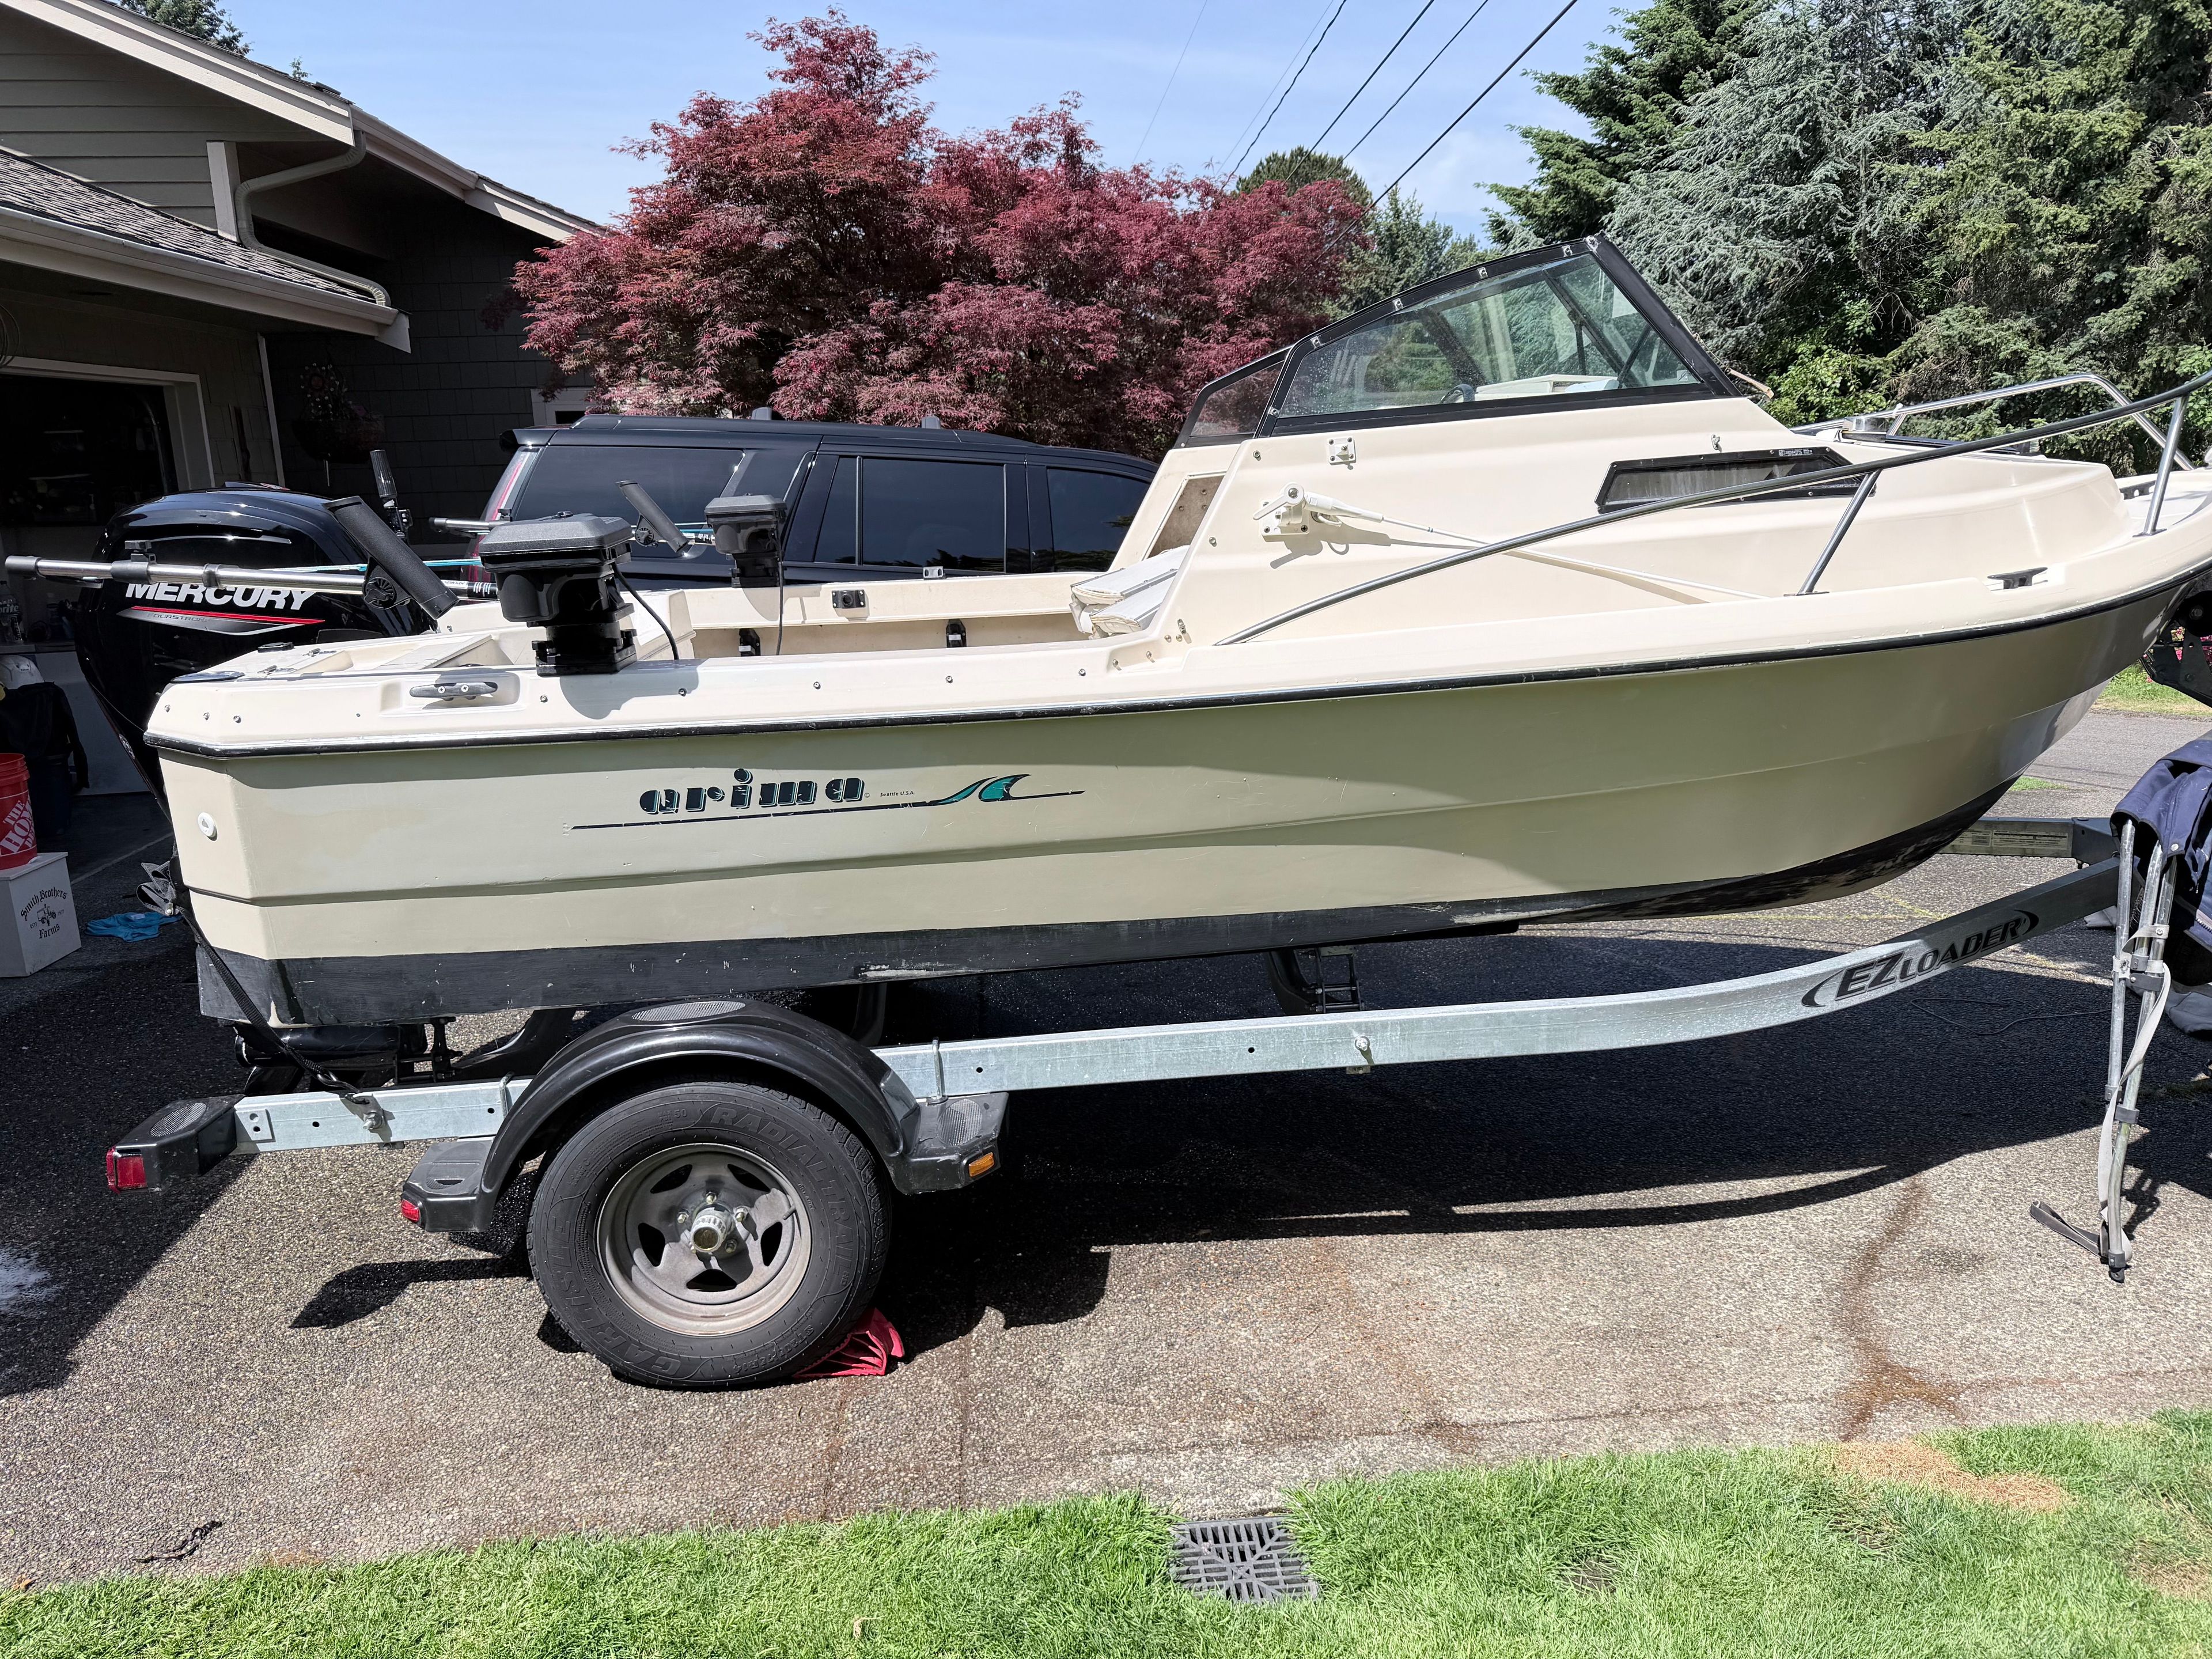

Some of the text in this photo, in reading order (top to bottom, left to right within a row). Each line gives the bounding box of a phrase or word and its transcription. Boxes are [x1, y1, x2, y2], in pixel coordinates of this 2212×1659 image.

[126, 582, 316, 611] MERCURY
[147, 613, 211, 623] FOURSTROKE
[639, 768, 866, 815] arima
[3, 800, 25, 825] THE
[20, 887, 67, 922] Smith Brothers
[39, 923, 60, 939] Farms
[673, 1108, 688, 1118] 50
[710, 1106, 828, 1183] RADIAL
[821, 1180, 854, 1277] TRAIL
[551, 1215, 681, 1376] CARLISLE
